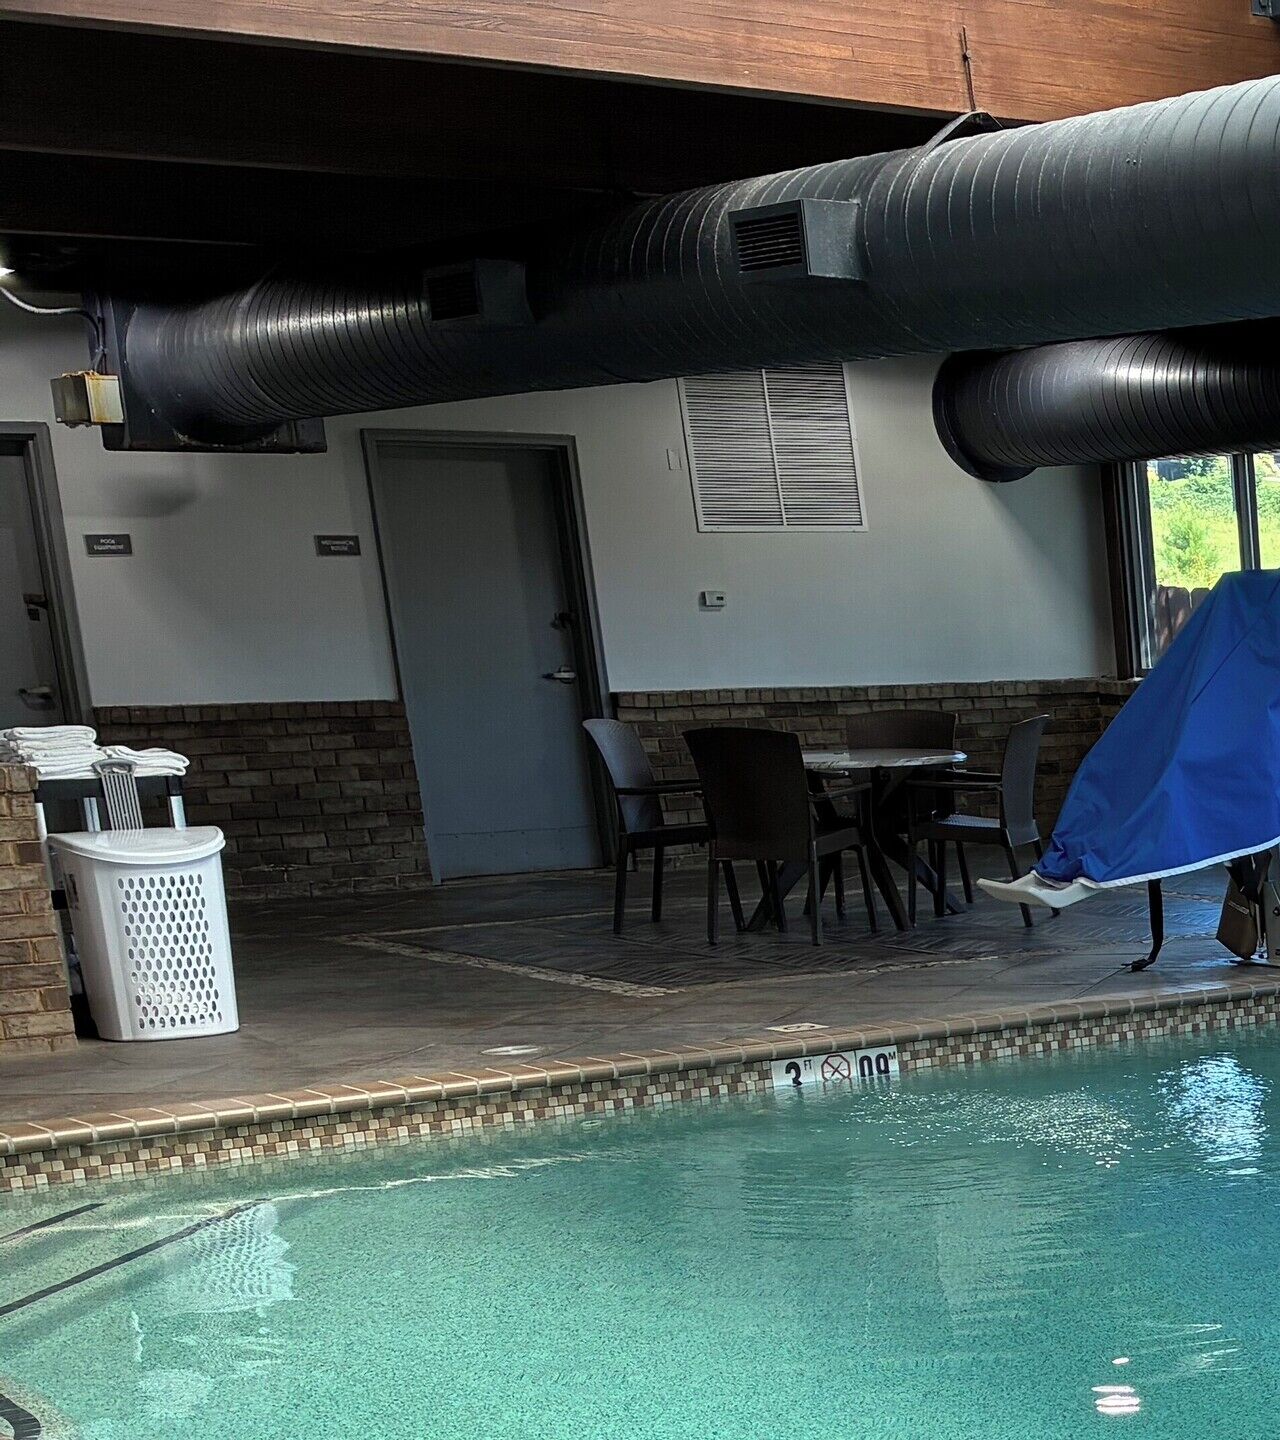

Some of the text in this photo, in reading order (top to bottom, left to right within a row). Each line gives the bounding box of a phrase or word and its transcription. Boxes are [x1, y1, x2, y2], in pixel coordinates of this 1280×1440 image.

[785, 1061, 803, 1088] 3
[803, 1059, 812, 1071] FT
[888, 1051, 897, 1060] M
